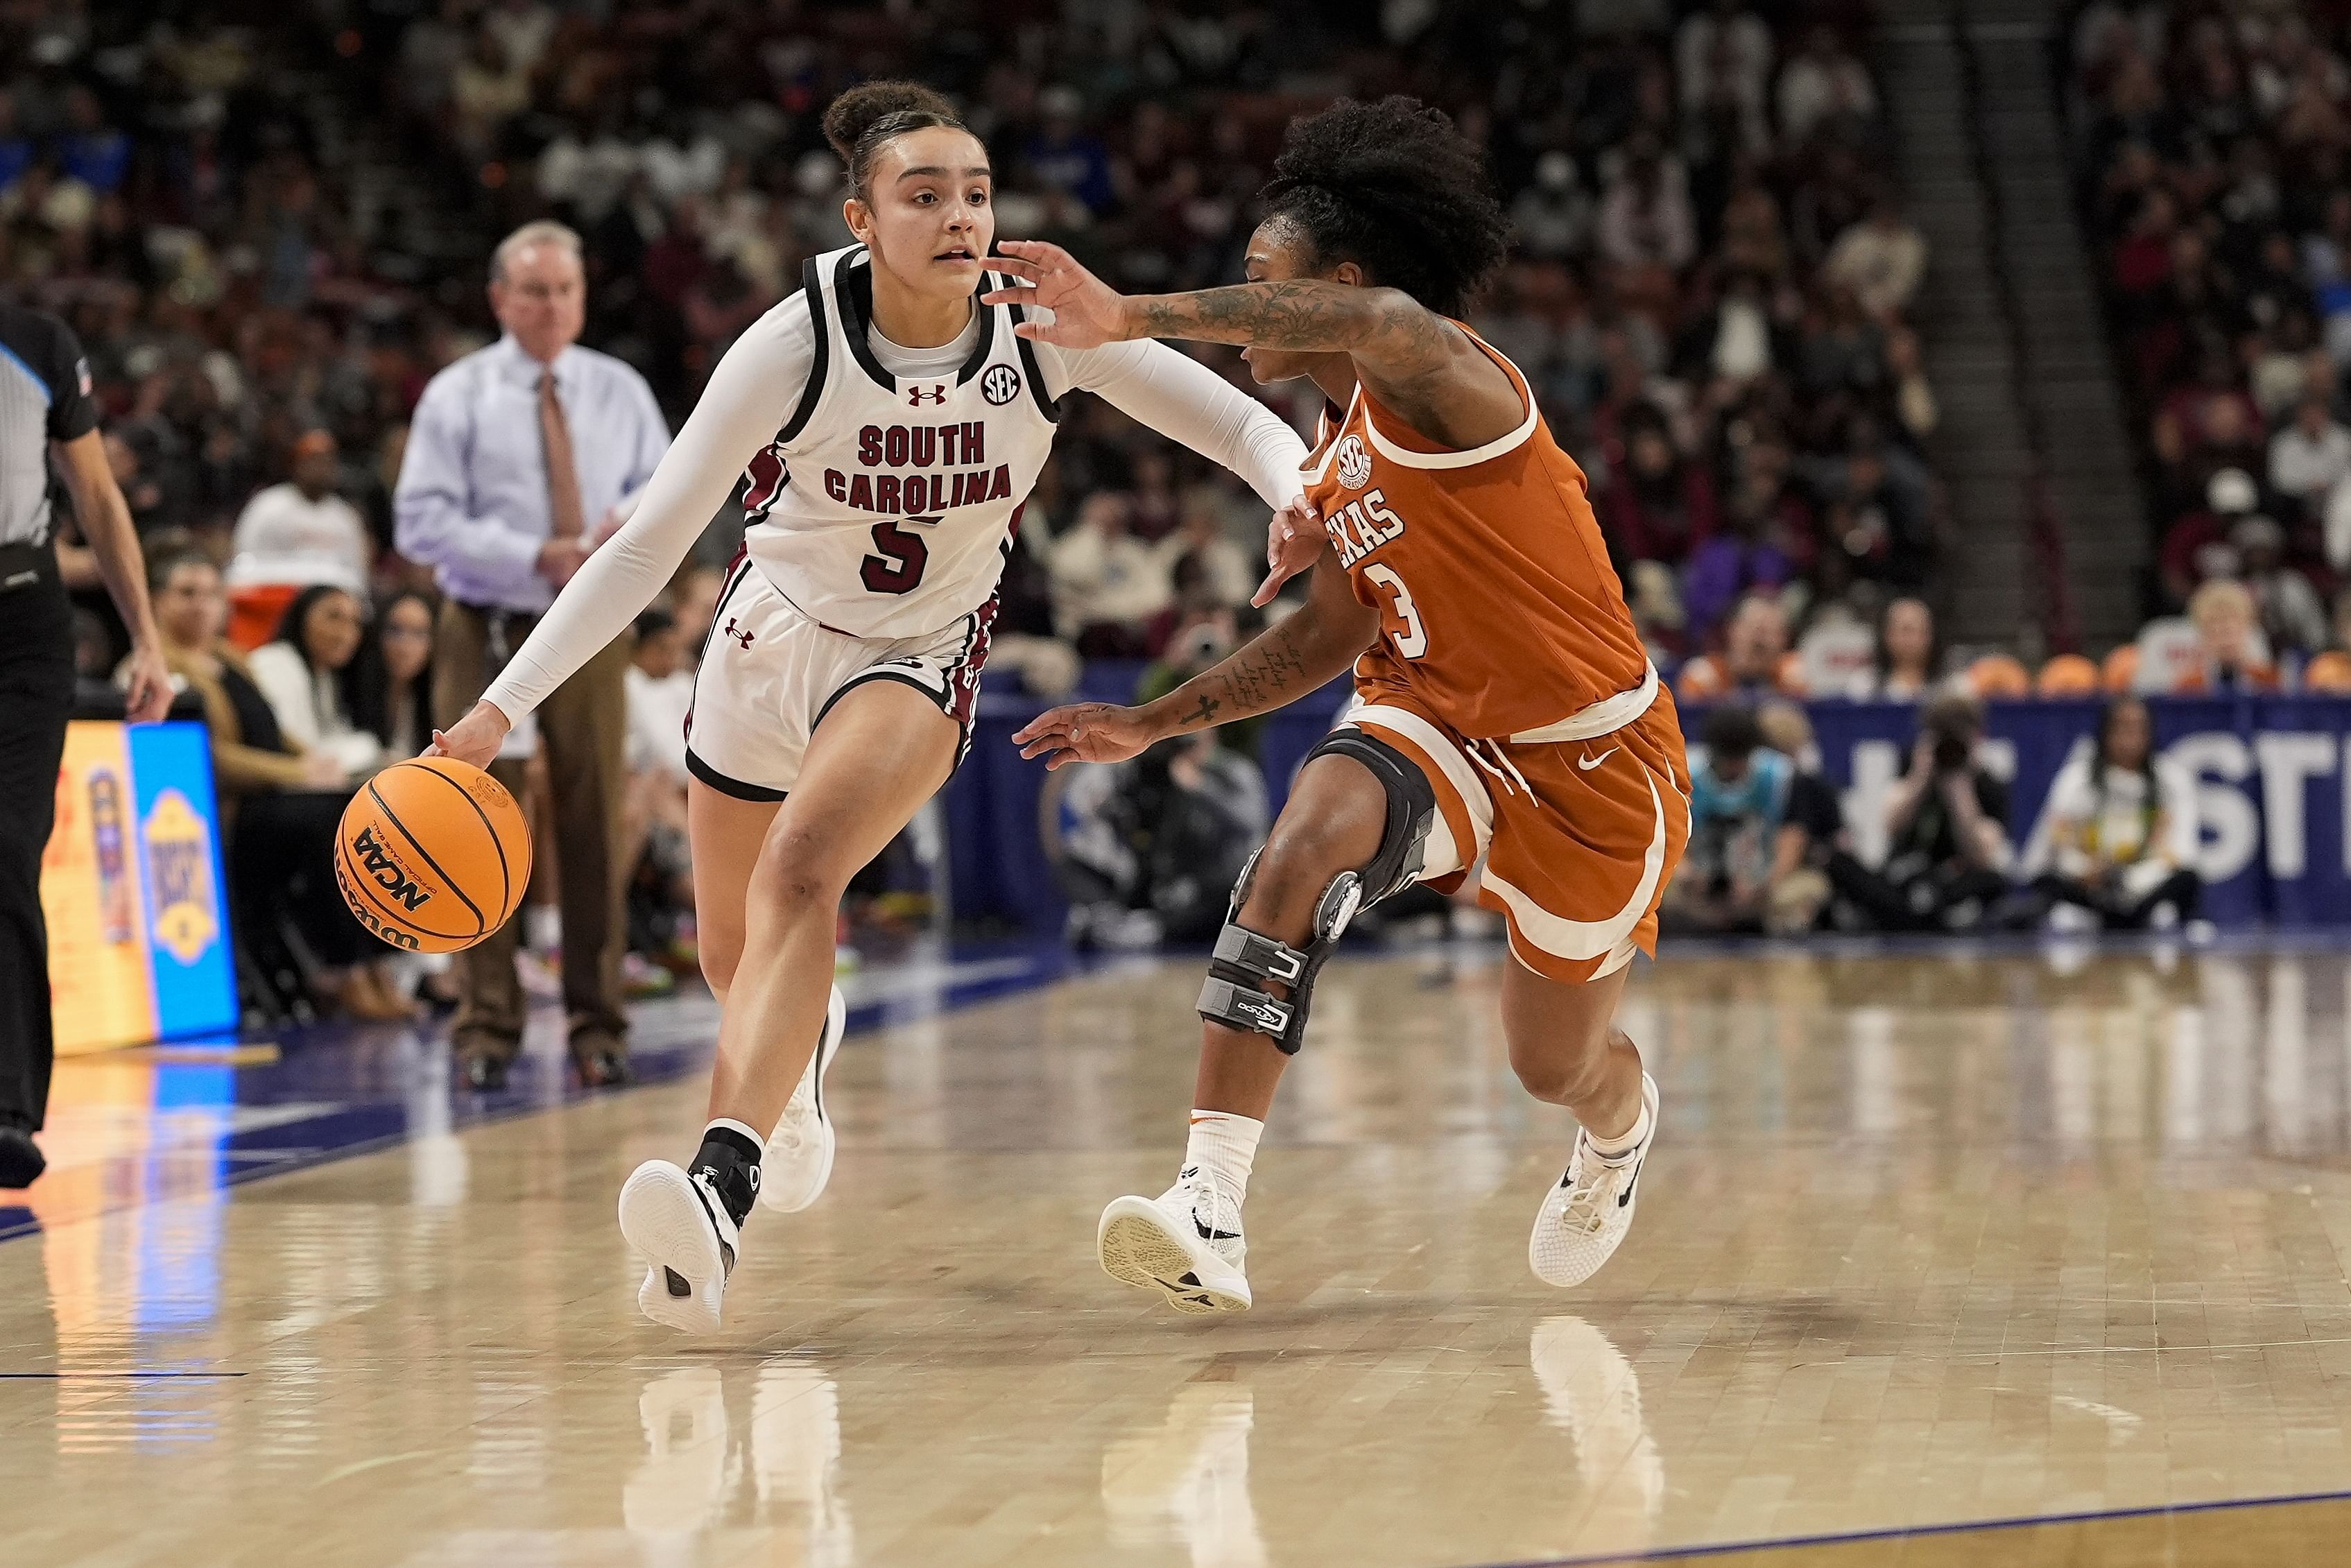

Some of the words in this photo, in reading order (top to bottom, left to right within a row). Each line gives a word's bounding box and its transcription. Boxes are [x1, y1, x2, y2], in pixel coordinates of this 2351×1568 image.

[984, 366, 1017, 403] SEC
[858, 421, 985, 467] SOUTH
[1339, 438, 1363, 476] SEC
[824, 463, 1012, 515] CAROLINA
[1343, 466, 1370, 489] GRADUATE
[859, 516, 945, 595] 5
[1363, 562, 1428, 660] 3
[372, 820, 386, 841] BALL
[352, 826, 431, 913] NCAA
[384, 840, 404, 864] GAME
[404, 864, 438, 895] OFFICIAL
